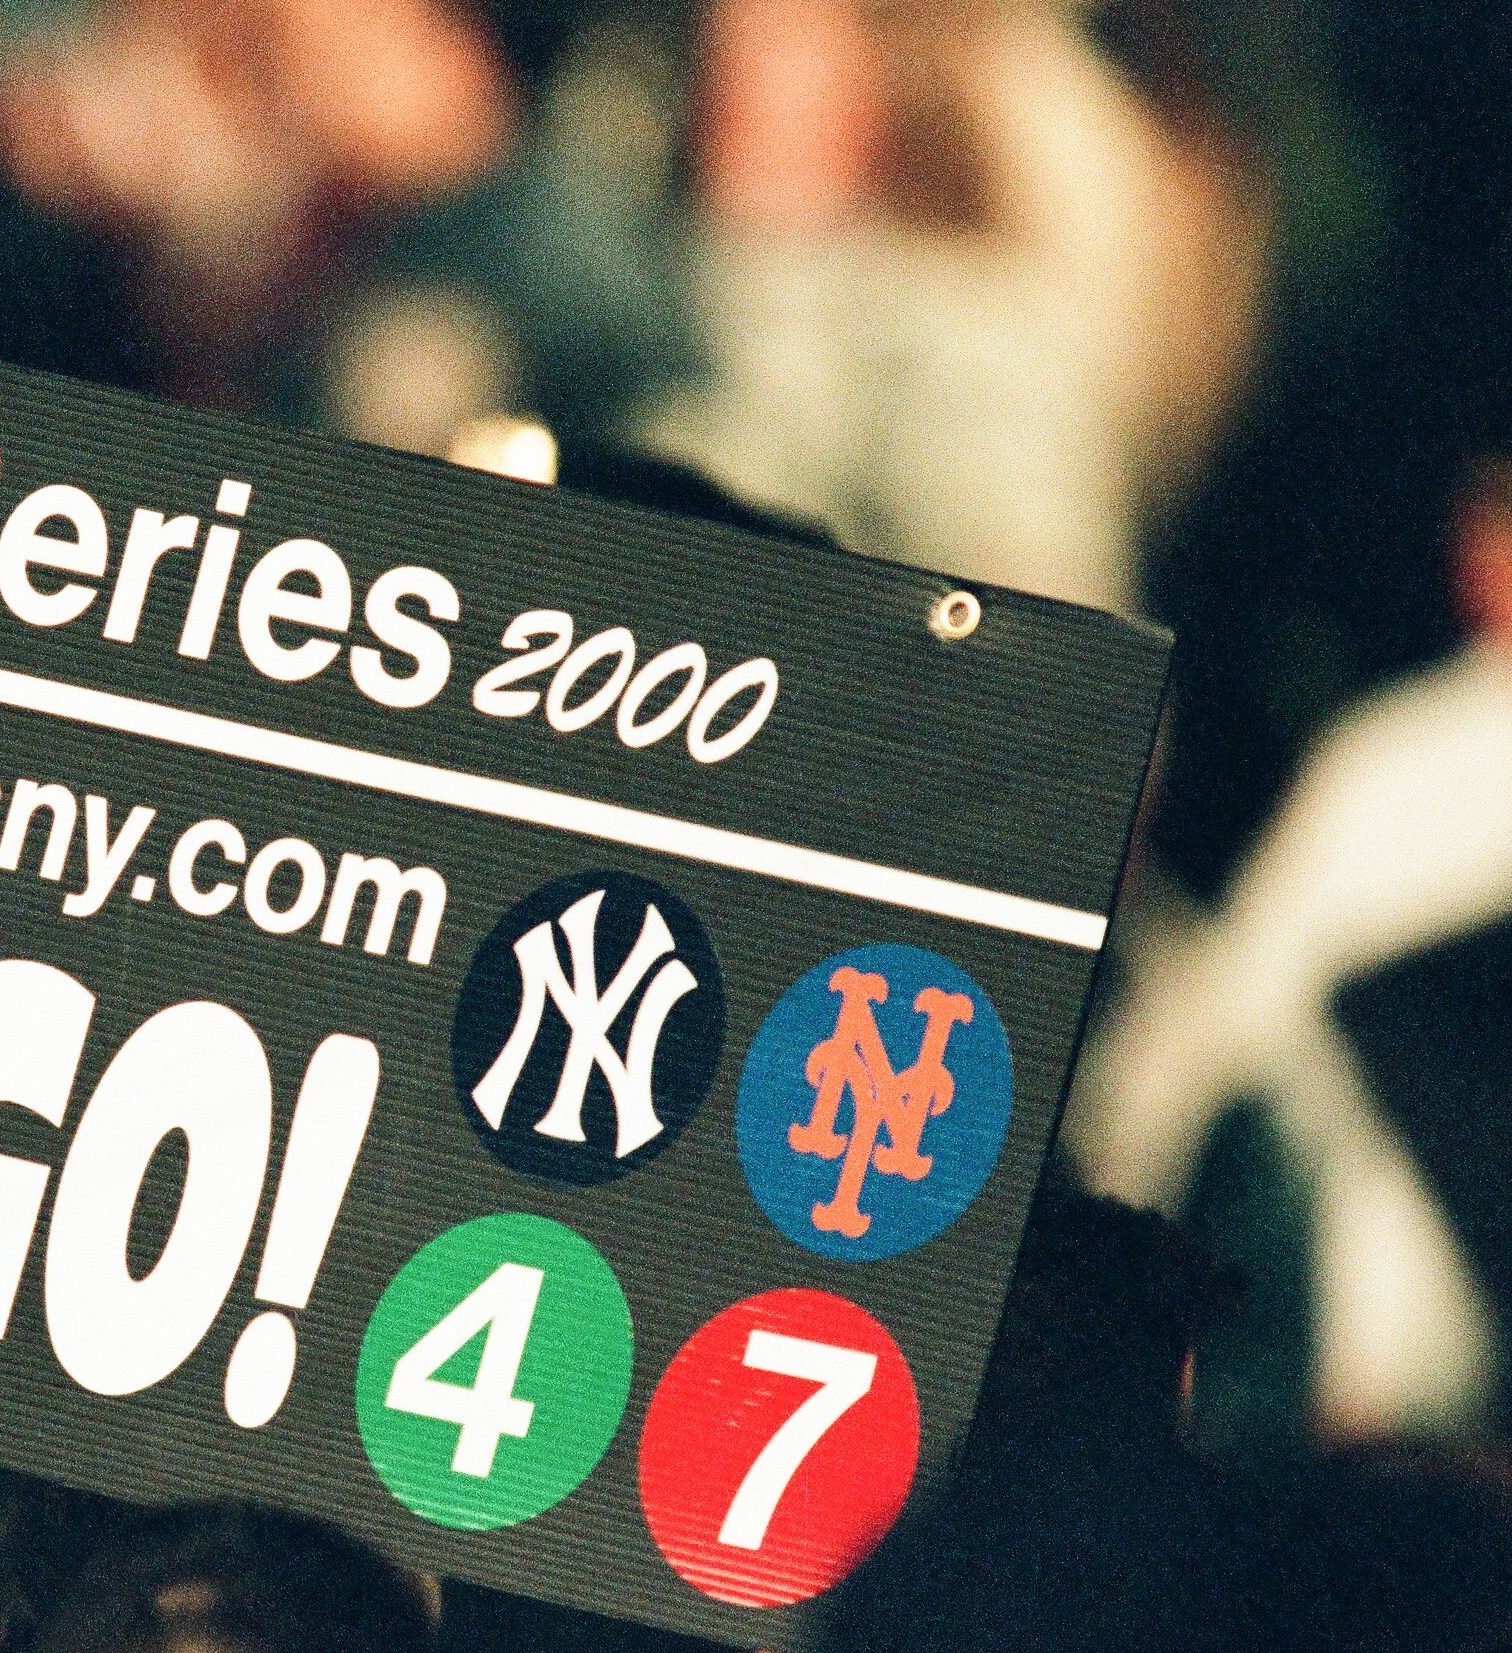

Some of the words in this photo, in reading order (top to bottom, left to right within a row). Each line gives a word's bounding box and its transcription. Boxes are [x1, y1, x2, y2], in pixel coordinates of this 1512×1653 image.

[472, 609, 779, 764] 2000
[384, 1261, 545, 1479] 4
[718, 1329, 878, 1551] 7
